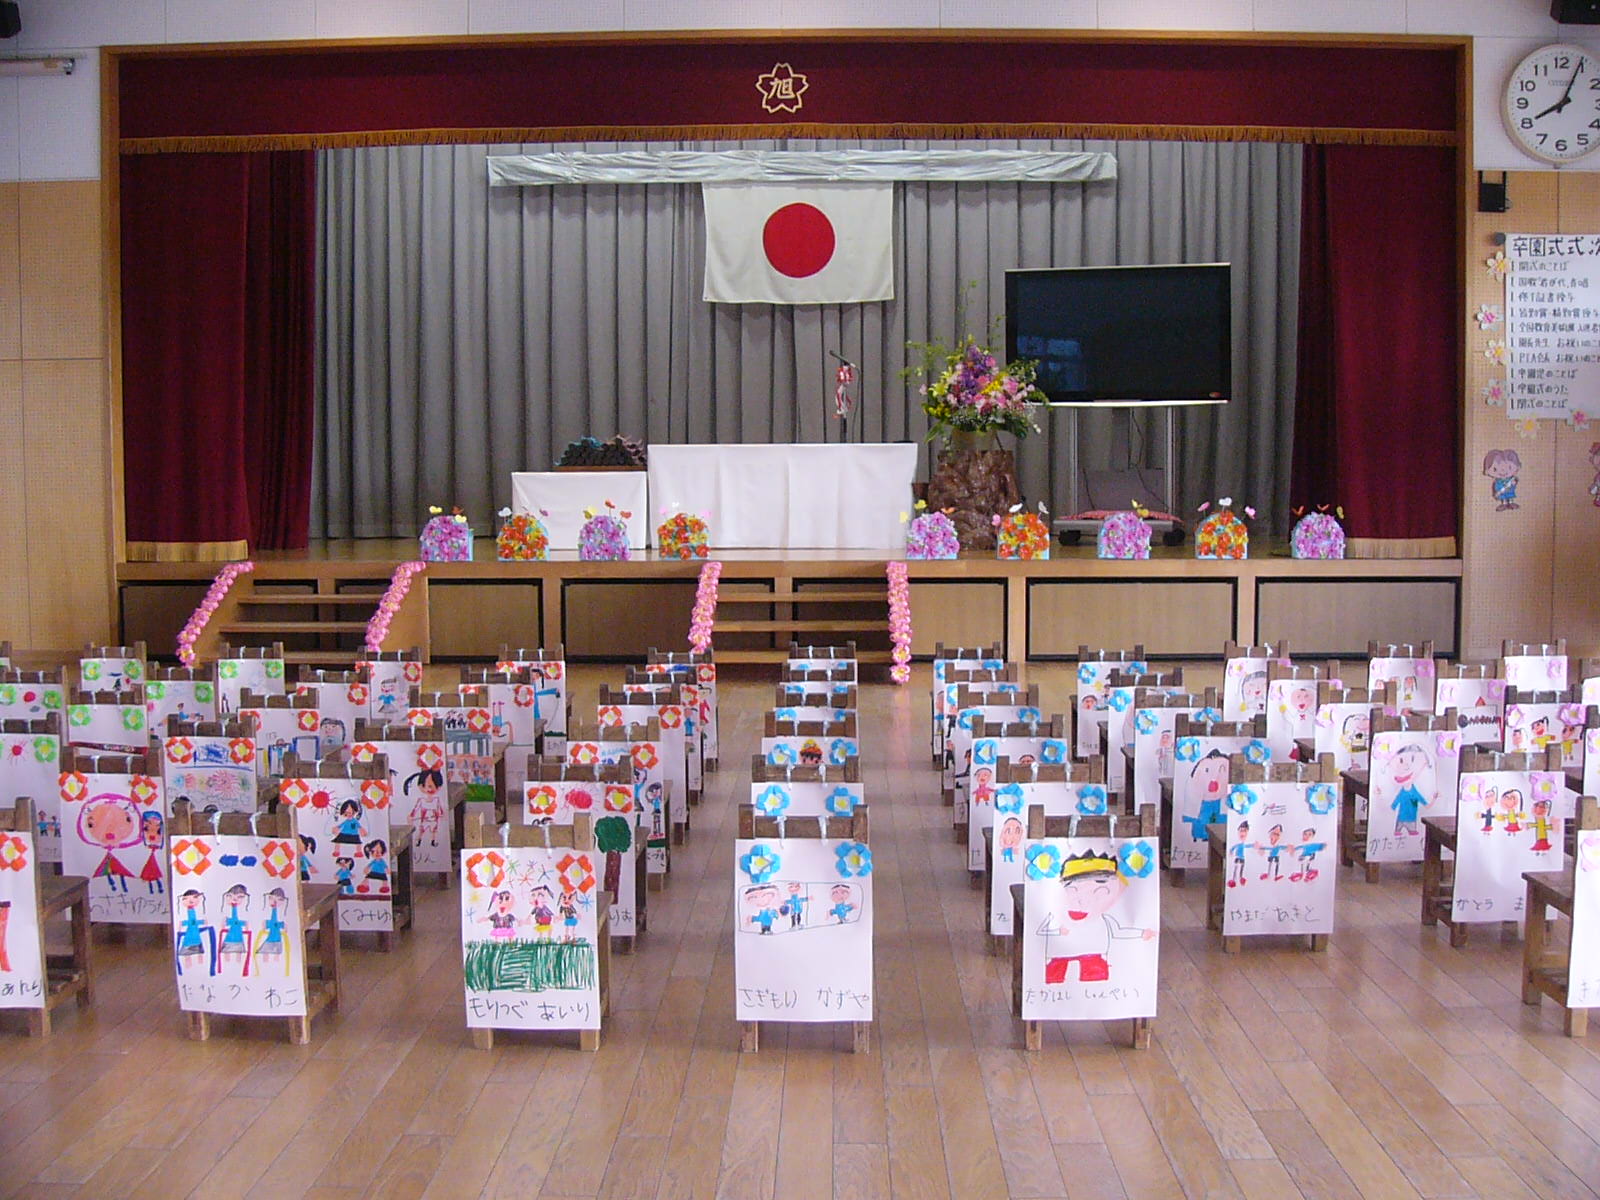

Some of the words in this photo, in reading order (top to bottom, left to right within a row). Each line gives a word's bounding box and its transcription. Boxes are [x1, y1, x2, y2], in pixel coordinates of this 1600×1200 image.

[1554, 57, 1570, 69] 12
[1534, 65, 1548, 76] 11
[768, 77, 796, 99] 旭
[1520, 80, 1536, 92] 10
[1589, 79, 1600, 90] 2
[1516, 97, 1529, 109] 9
[1521, 118, 1534, 129] 8
[1588, 118, 1600, 130] 4
[1536, 133, 1548, 145] 7
[1577, 133, 1589, 145] 5
[1555, 140, 1567, 151] 6
[182, 984, 250, 1003] たなか
